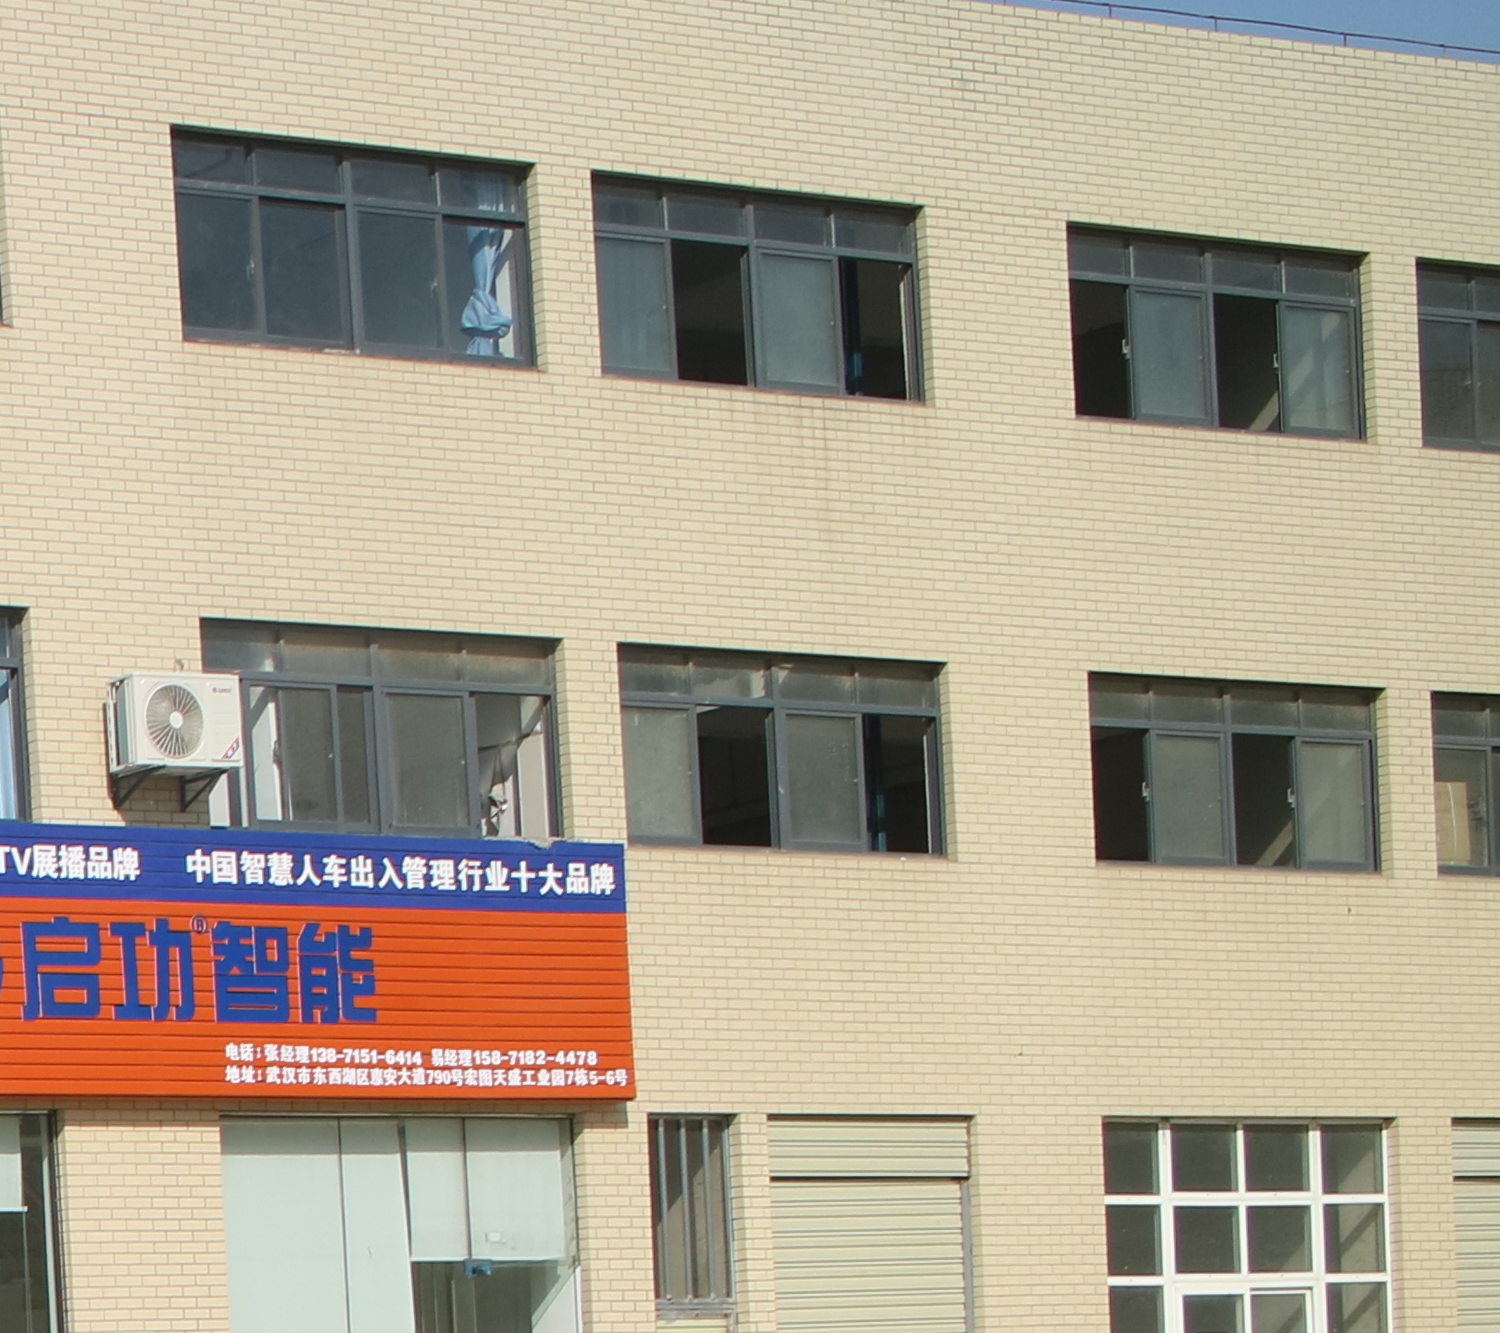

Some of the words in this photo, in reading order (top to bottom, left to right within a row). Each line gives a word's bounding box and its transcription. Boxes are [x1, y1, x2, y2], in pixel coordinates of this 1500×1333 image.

[186, 848, 616, 896] 中国智慧人车出入管理行业十大品牌
